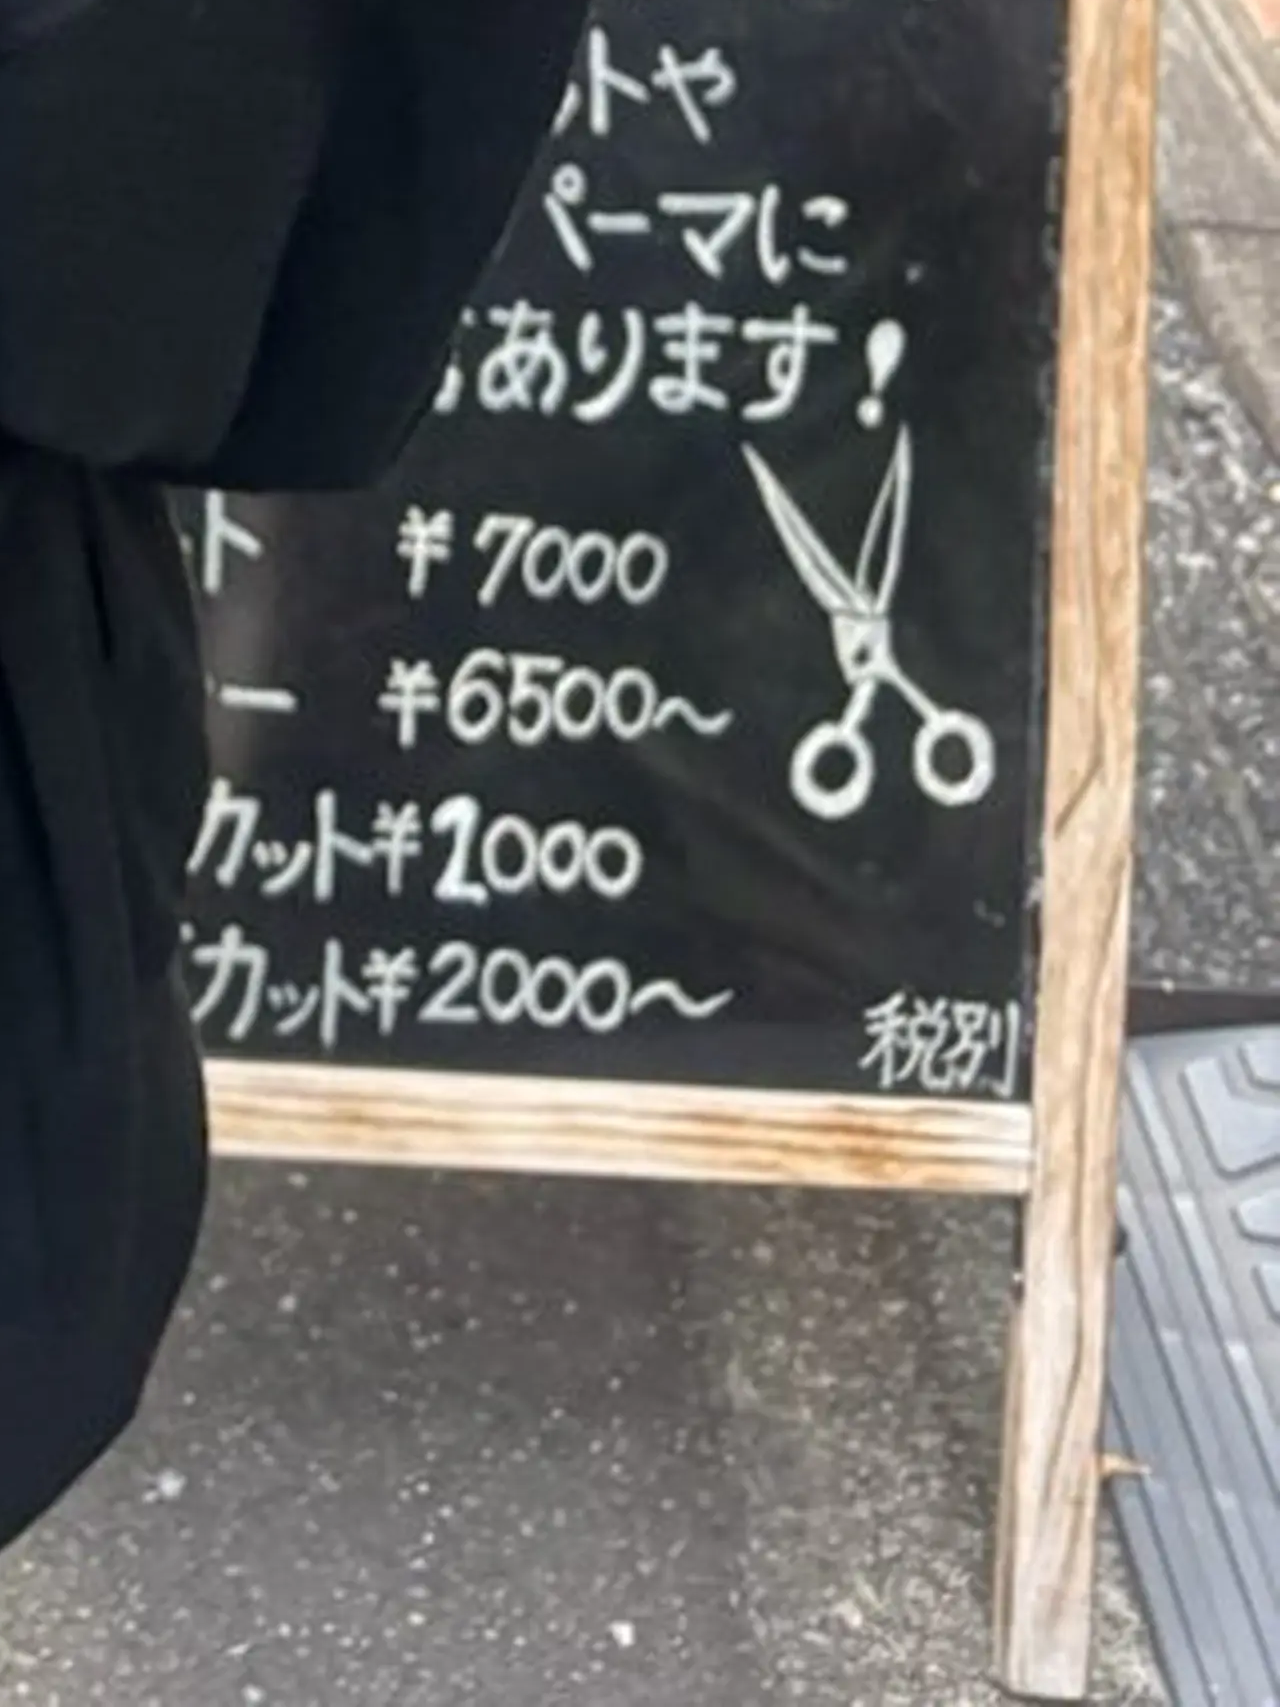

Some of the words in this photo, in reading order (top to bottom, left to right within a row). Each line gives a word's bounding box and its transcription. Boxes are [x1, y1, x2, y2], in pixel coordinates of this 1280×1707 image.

[435, 299, 905, 427] あります!
[397, 506, 668, 605] ¥7000
[857, 991, 1021, 1099] 税別
